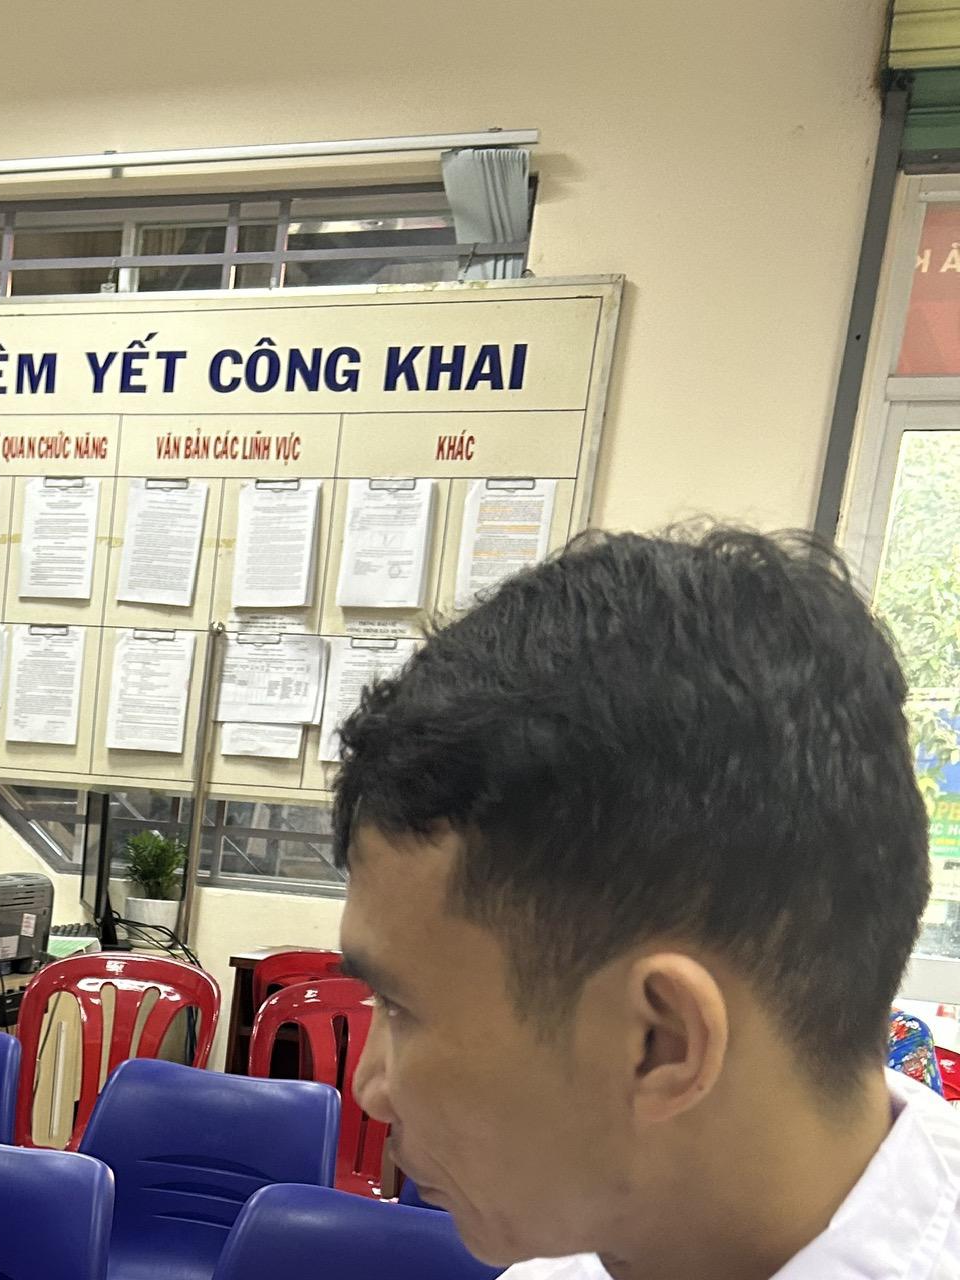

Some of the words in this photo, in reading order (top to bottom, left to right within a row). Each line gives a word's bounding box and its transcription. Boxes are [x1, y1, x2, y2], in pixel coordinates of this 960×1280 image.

[85, 332, 188, 394] YẾT
[208, 337, 361, 394] CÔNG
[383, 343, 528, 392] KHAI
[2, 435, 37, 463] QUAN
[38, 430, 71, 459] CHỨC
[74, 431, 108, 459] NĂNG
[156, 432, 181, 459] VĂN
[184, 427, 211, 459] BẢN
[213, 430, 239, 460] CÁC
[242, 430, 271, 460] LĨNH
[275, 431, 301, 466] VỰC
[436, 429, 475, 460] KHÁC
